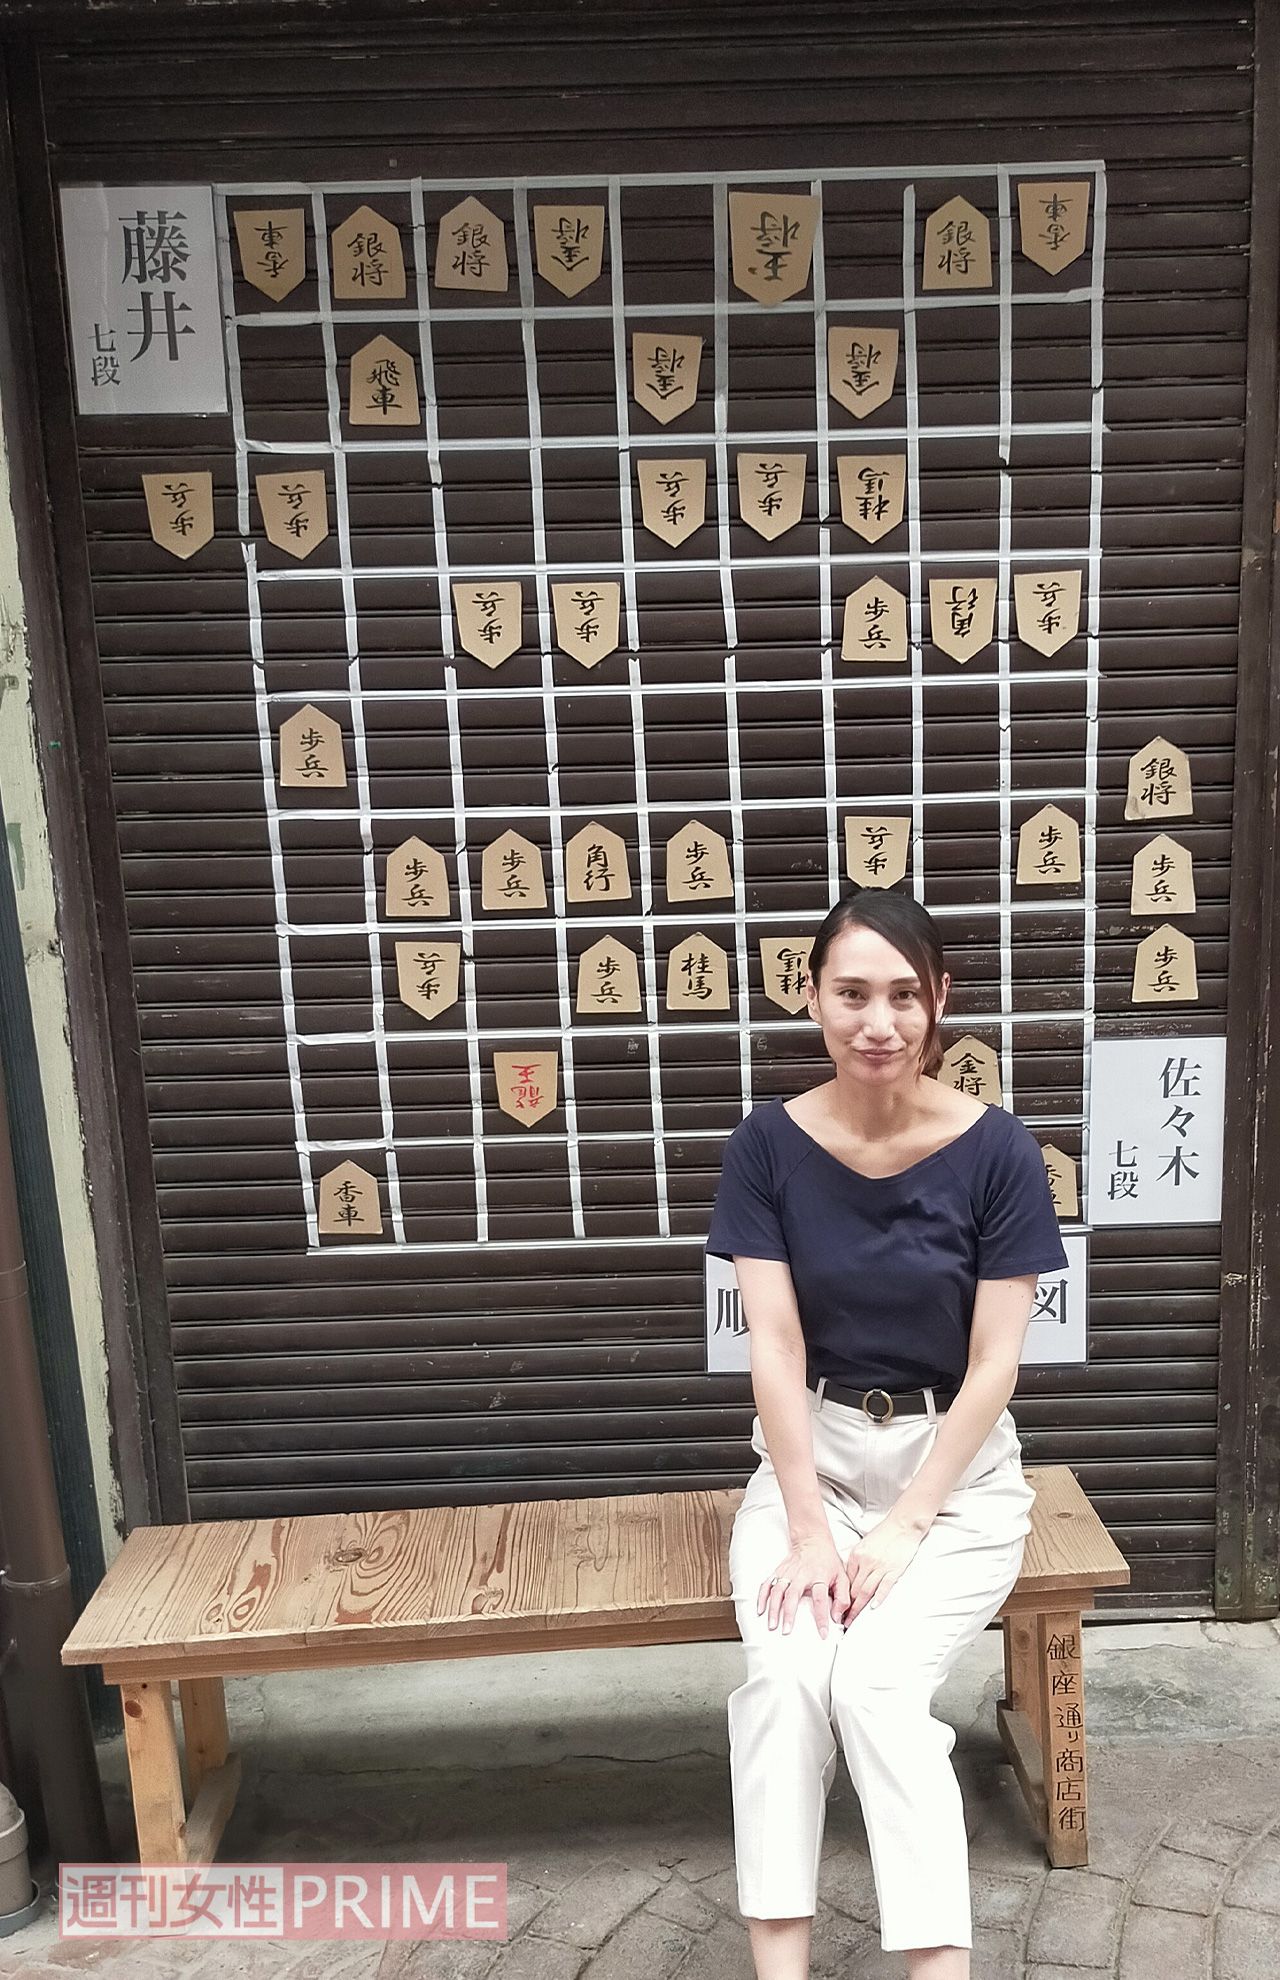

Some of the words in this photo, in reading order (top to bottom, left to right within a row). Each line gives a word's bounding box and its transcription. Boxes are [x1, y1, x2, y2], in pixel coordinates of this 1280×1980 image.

[550, 217, 590, 272] 金将
[936, 220, 976, 275] 銀将
[1038, 192, 1073, 251] 香車
[253, 220, 289, 279] 香車
[346, 232, 389, 287] 銀将
[451, 222, 491, 278] 銀将
[119, 210, 195, 363] 藤井
[89, 322, 121, 387] 七段
[645, 345, 686, 401] 金将
[842, 341, 882, 396] 金将
[365, 358, 403, 416] 飛車
[161, 482, 195, 537] 歩兵
[277, 483, 312, 538] 歩兵
[655, 471, 690, 526] 歩兵
[754, 462, 789, 517] 歩兵
[854, 466, 891, 522] 桂馬
[471, 591, 505, 645] 歩兵
[570, 590, 605, 643] 歩兵
[858, 596, 892, 650] 歩兵
[944, 585, 979, 639] 角行
[1032, 581, 1066, 635] 歩兵
[295, 727, 329, 778] 歩兵
[1140, 757, 1178, 806] 銀将
[497, 848, 531, 898] 歩兵
[583, 843, 616, 892] 角行
[682, 840, 715, 891] 歩兵
[860, 826, 894, 876] 歩兵
[1033, 825, 1066, 875] 歩兵
[401, 857, 434, 907] 歩兵
[1145, 853, 1177, 903] 歩兵
[412, 952, 446, 1001] 歩兵
[591, 956, 623, 1007] 歩兵
[680, 952, 714, 1000] 桂馬
[1148, 945, 1180, 993] 歩兵
[511, 1064, 545, 1109] 龍王
[952, 1053, 987, 1097] 金将
[1155, 1056, 1204, 1188] 佐々木
[1107, 1139, 1140, 1202] 七段
[333, 1180, 365, 1227] 香車
[1046, 1634, 1087, 1833] 銀座通り商店街
